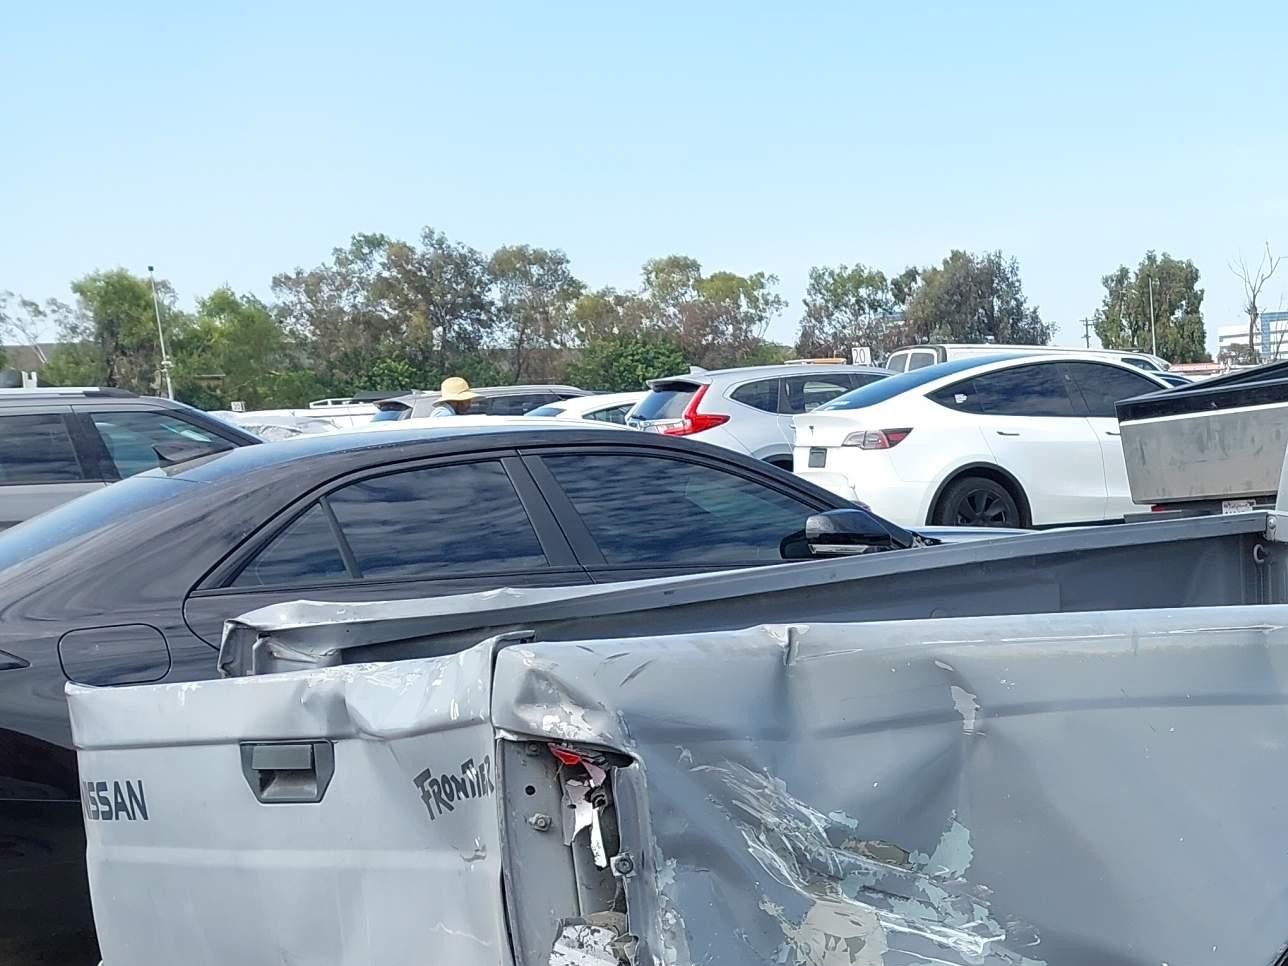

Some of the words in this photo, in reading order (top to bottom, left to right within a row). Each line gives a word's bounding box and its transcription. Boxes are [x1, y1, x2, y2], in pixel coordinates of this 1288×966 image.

[853, 349, 866, 363] 20
[82, 780, 149, 820] ISSAN
[413, 755, 494, 820] FRONTIER
